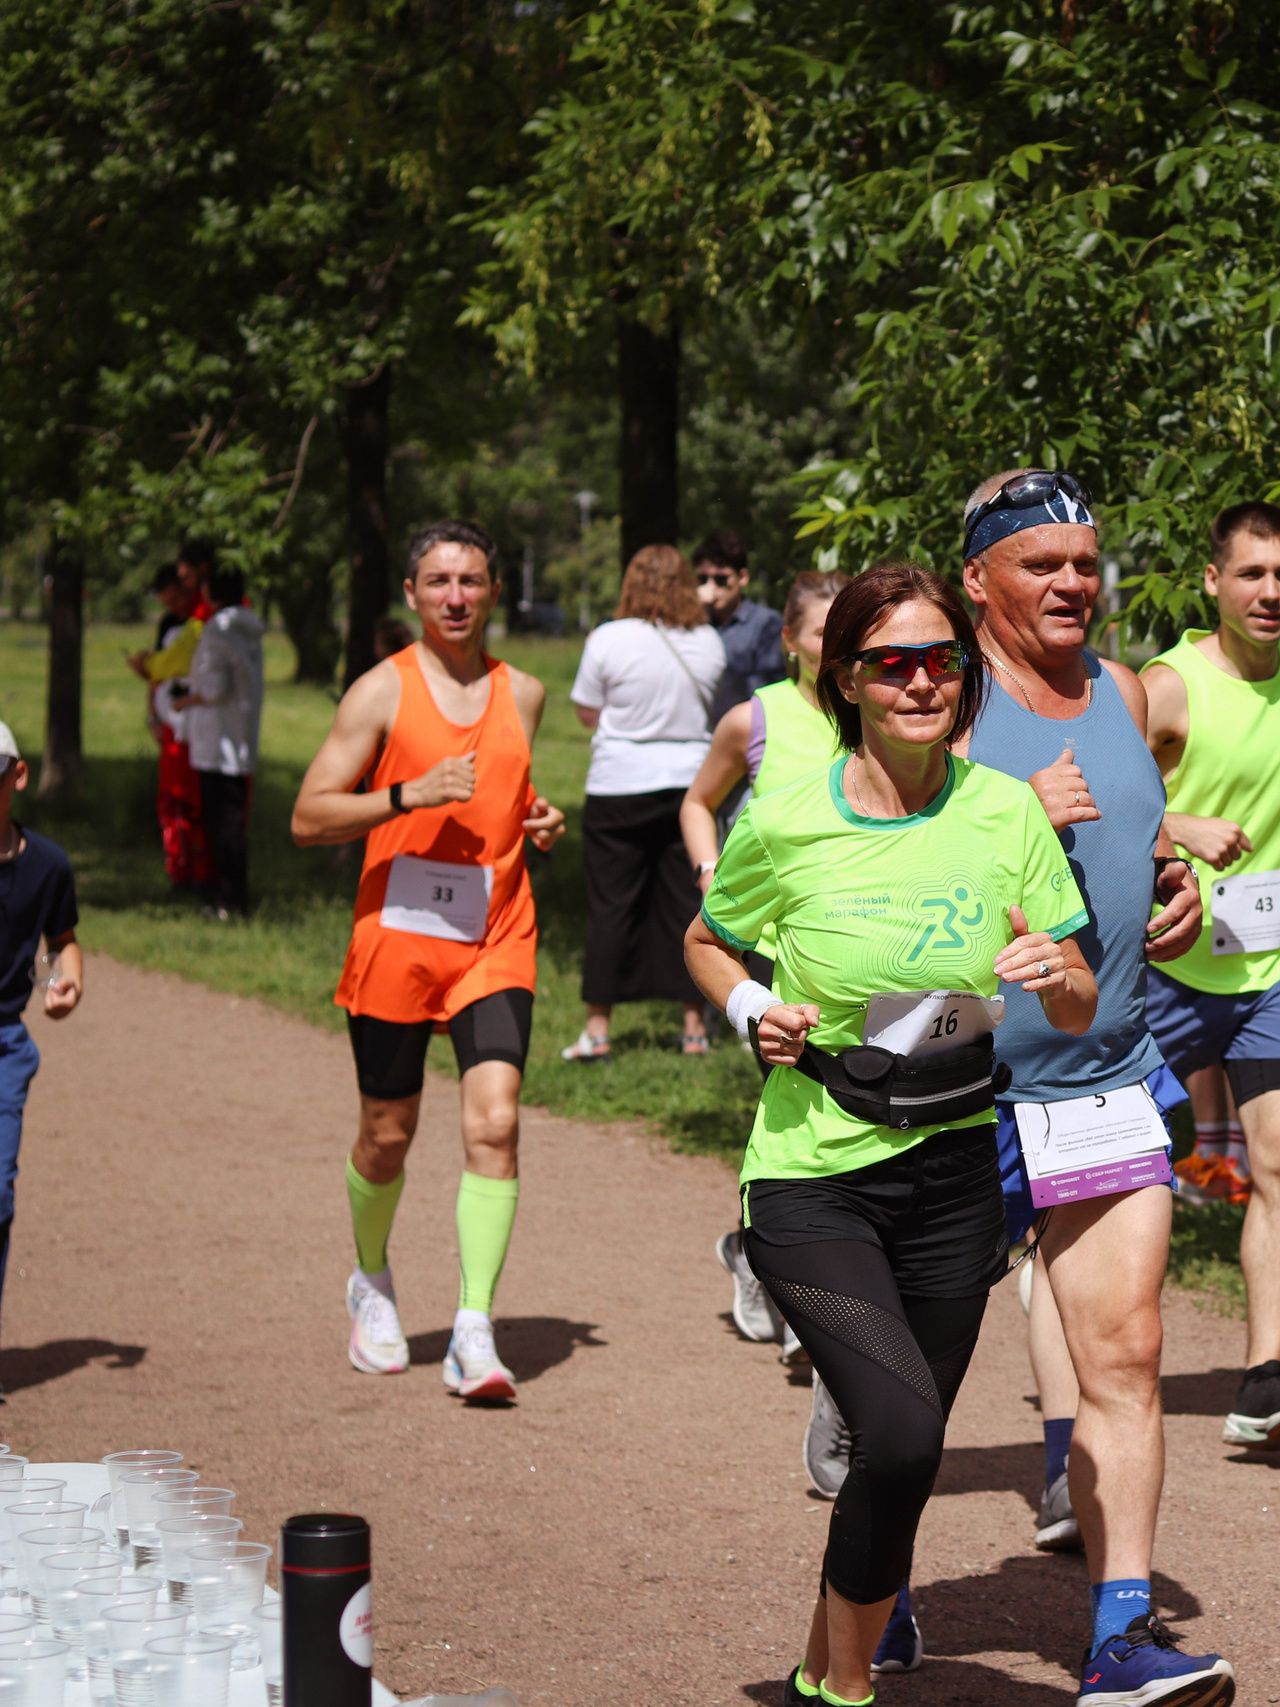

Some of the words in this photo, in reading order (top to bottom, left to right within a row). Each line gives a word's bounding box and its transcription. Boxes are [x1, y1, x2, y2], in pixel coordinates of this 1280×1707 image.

[432, 886, 453, 903] 33
[831, 892, 891, 908] зелёный
[824, 905, 888, 921] марафон
[1255, 897, 1274, 913] 43
[928, 1008, 960, 1040] 16
